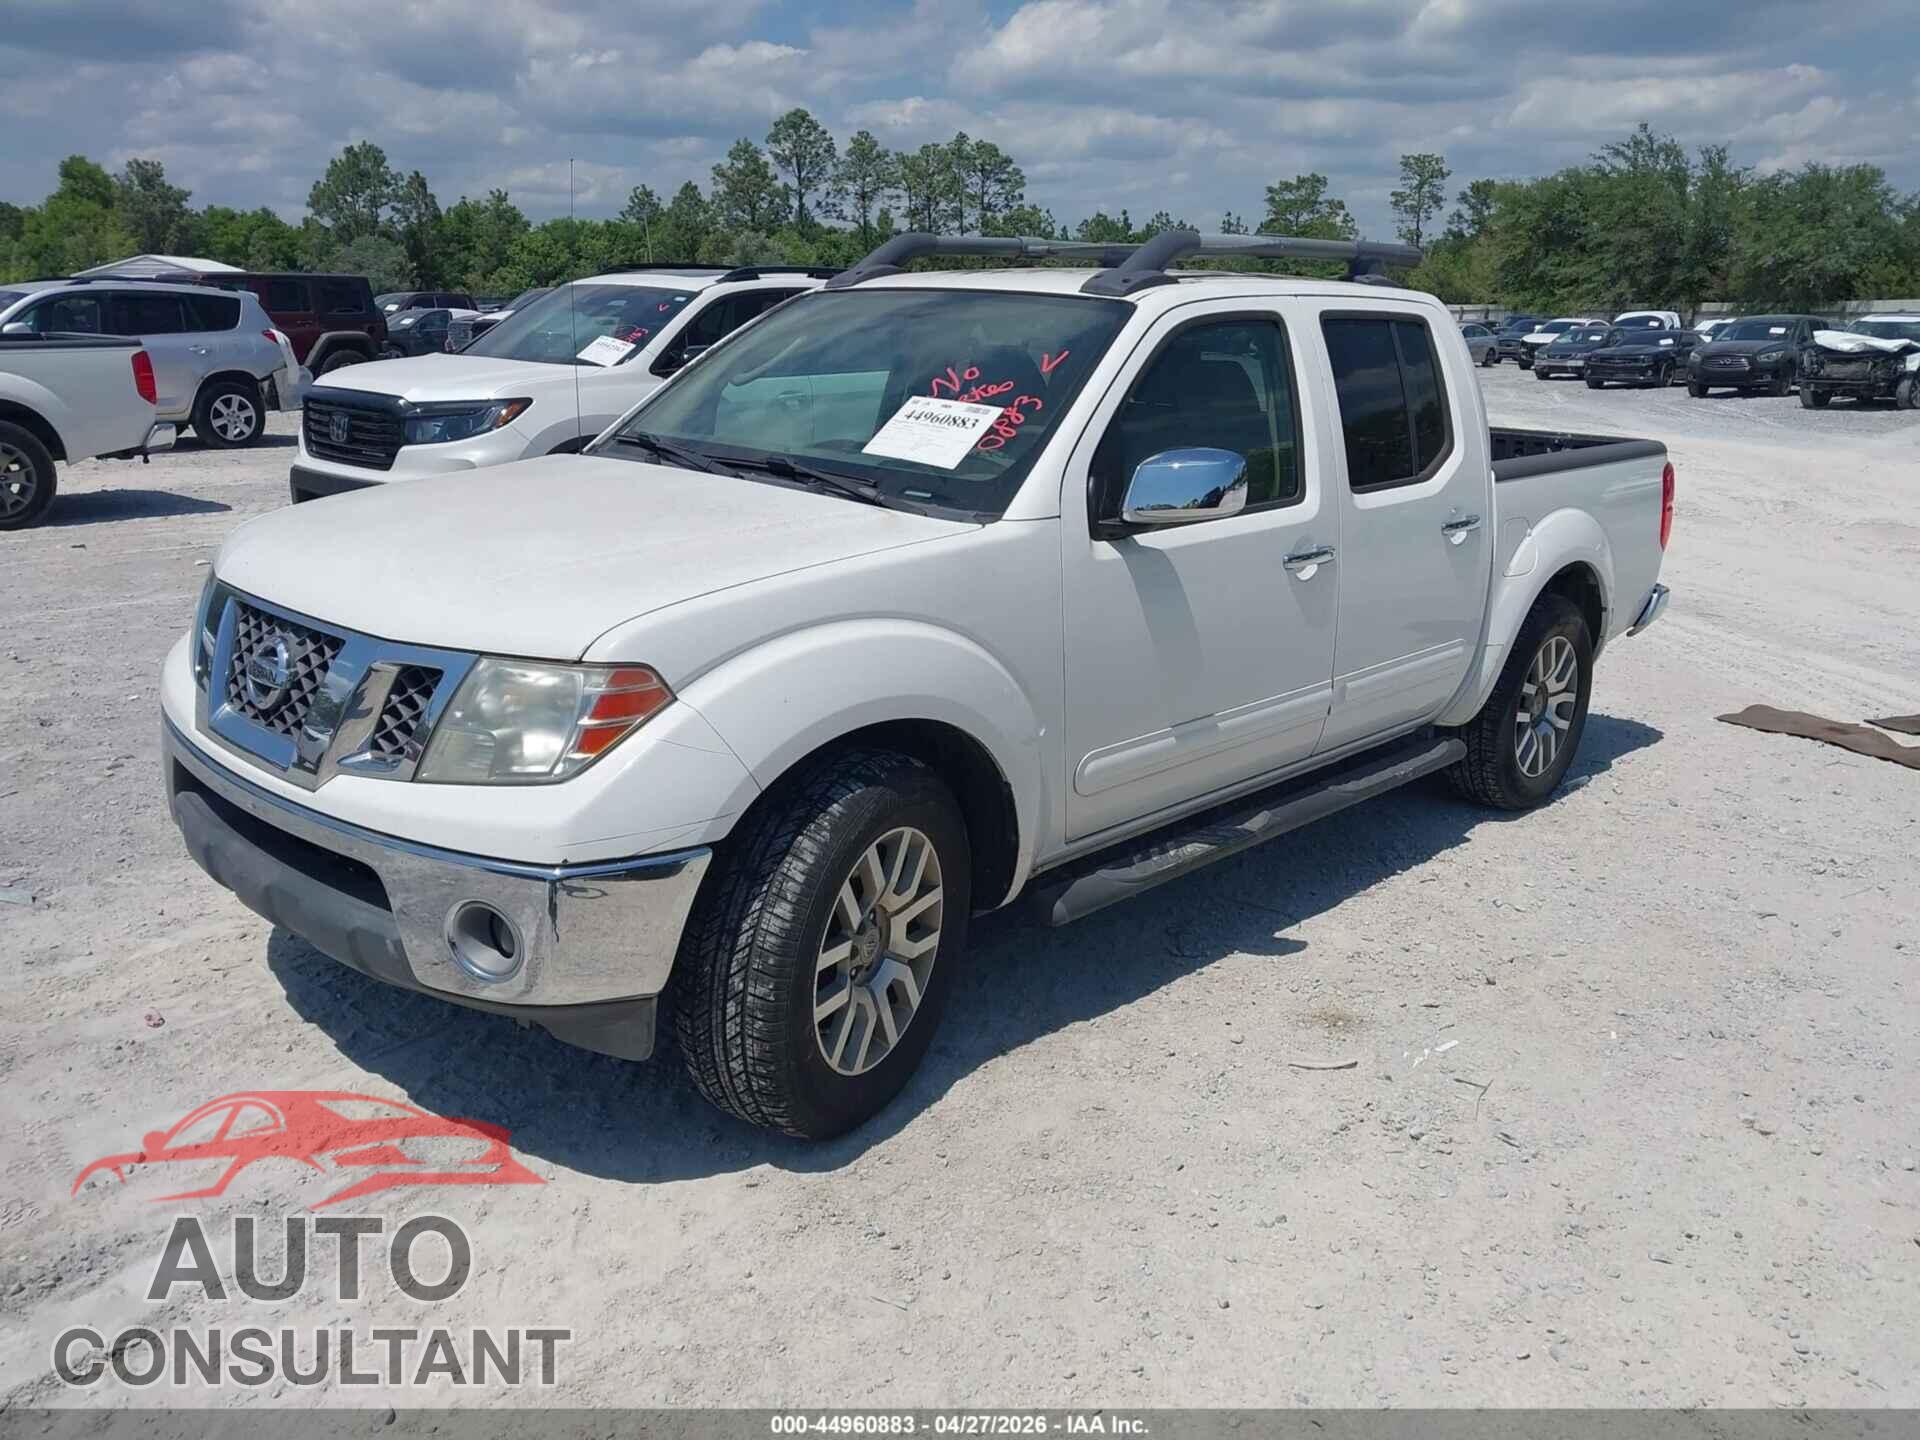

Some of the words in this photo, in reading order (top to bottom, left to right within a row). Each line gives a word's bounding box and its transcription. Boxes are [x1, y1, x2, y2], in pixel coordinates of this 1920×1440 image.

[932, 367, 980, 397] No
[903, 409, 980, 429] 44960883
[977, 395, 1042, 449] 0883
